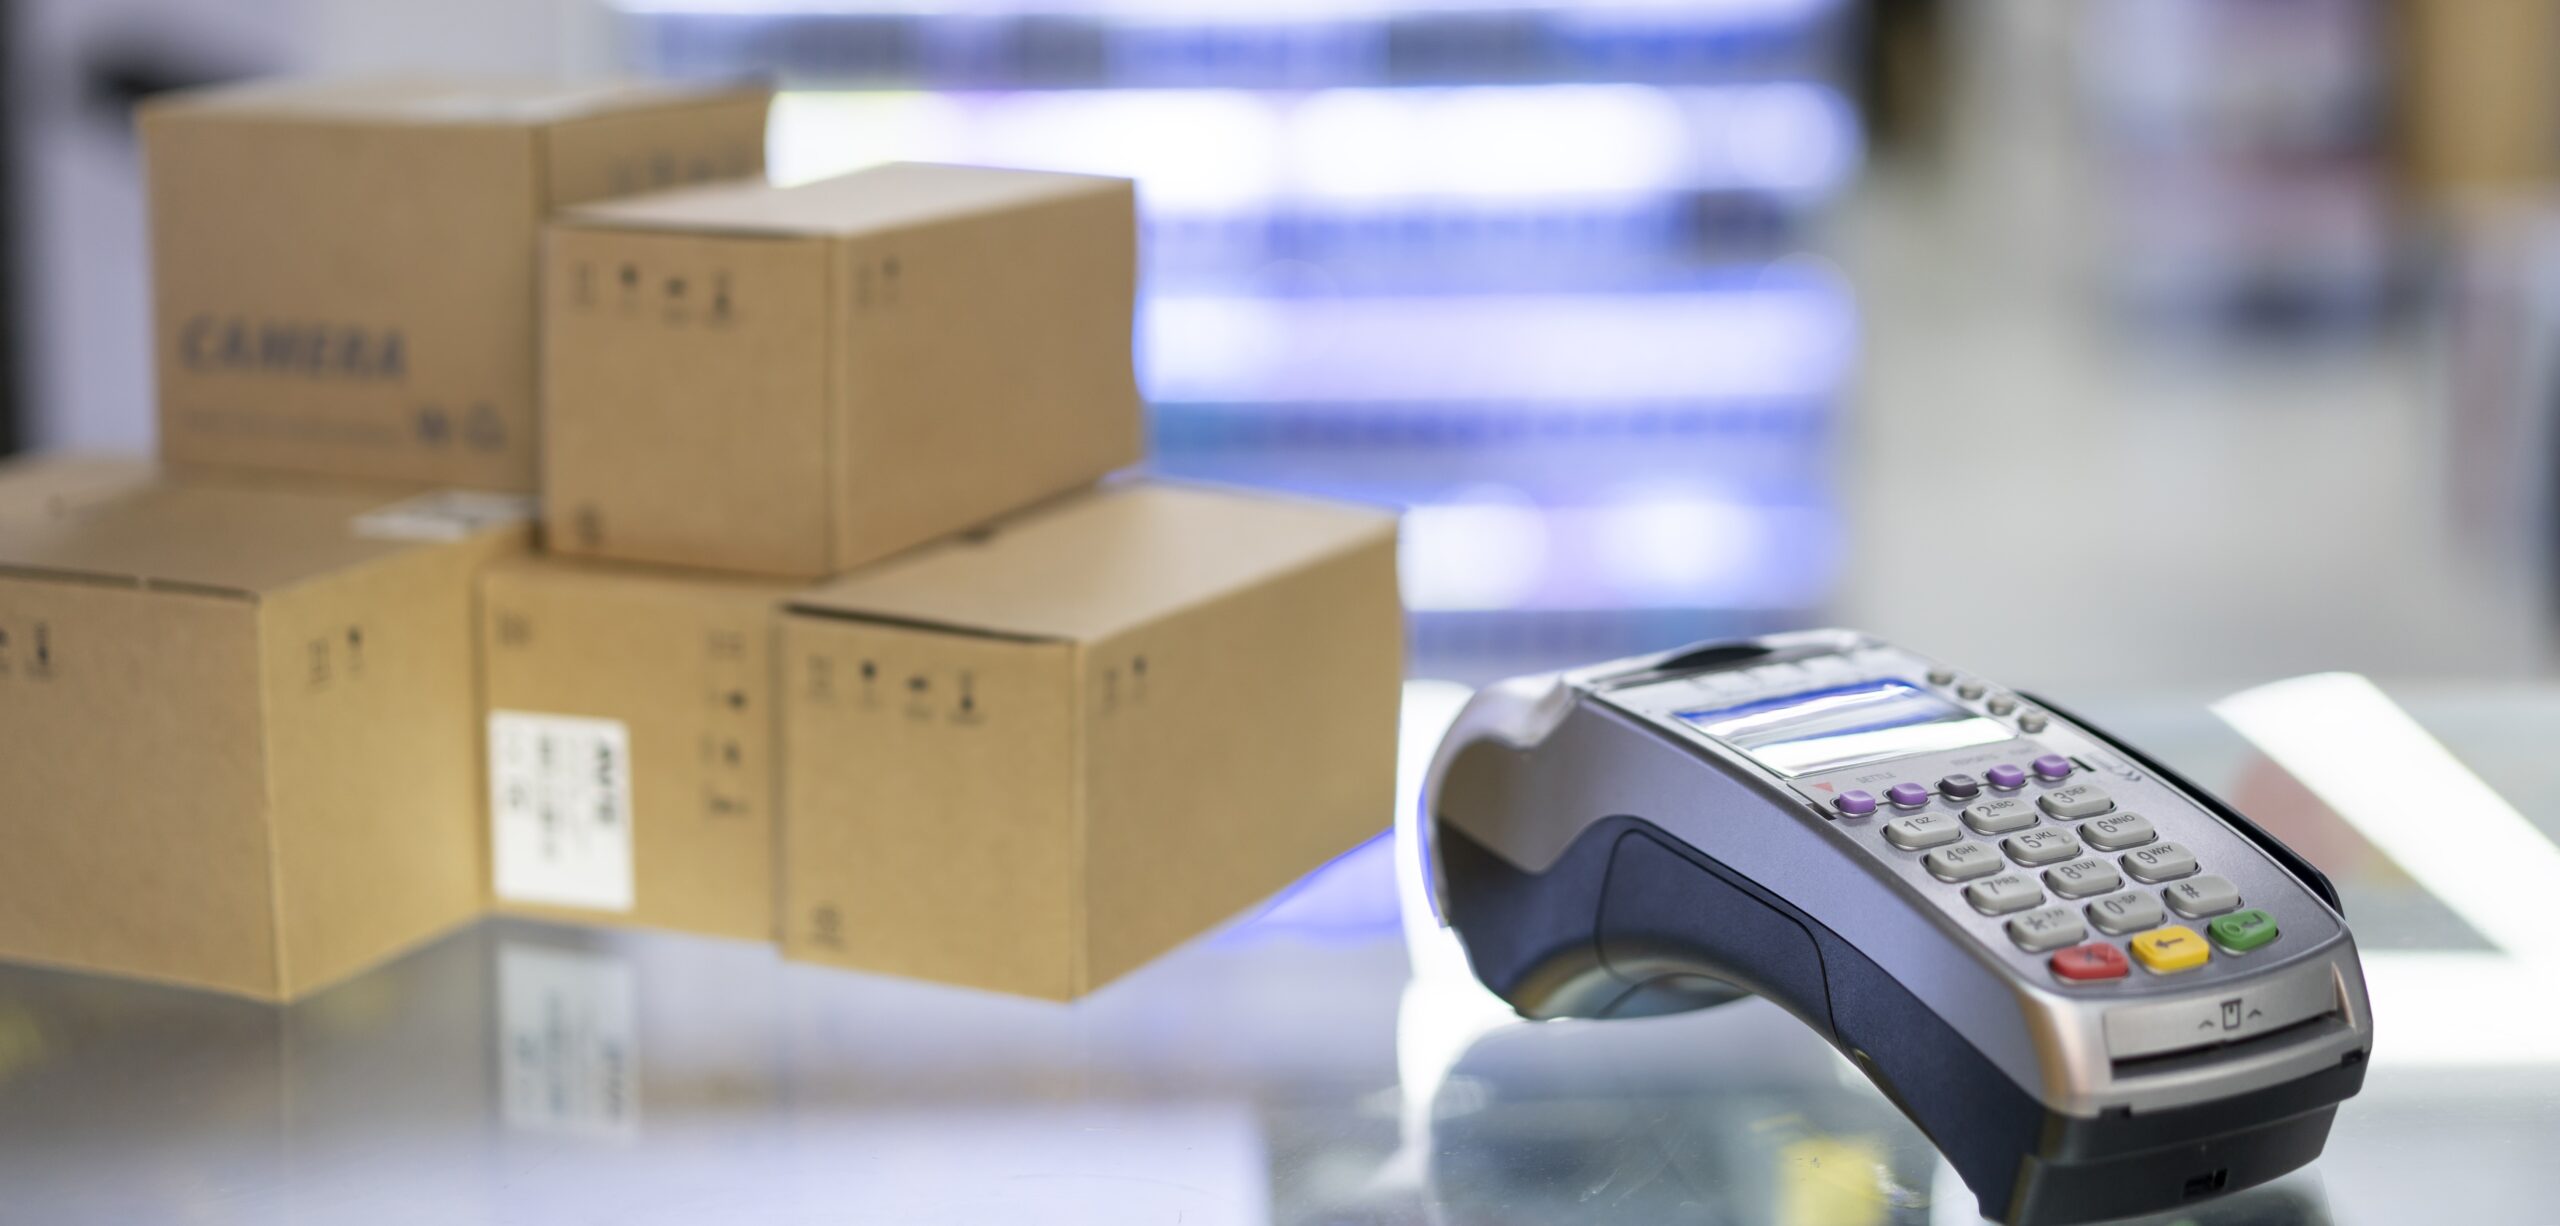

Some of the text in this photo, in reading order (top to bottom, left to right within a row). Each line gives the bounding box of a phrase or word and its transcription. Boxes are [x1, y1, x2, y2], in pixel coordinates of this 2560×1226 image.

[179, 312, 408, 380] CAMERA
[2053, 792, 2075, 804] 3
[1976, 806, 2000, 817] 2
[2097, 820, 2119, 833] 6
[2020, 835, 2042, 849] 5
[1946, 850, 1964, 863] 4
[2136, 850, 2158, 865] 9
[2060, 866, 2082, 880] 8
[1981, 880, 1999, 895] 7
